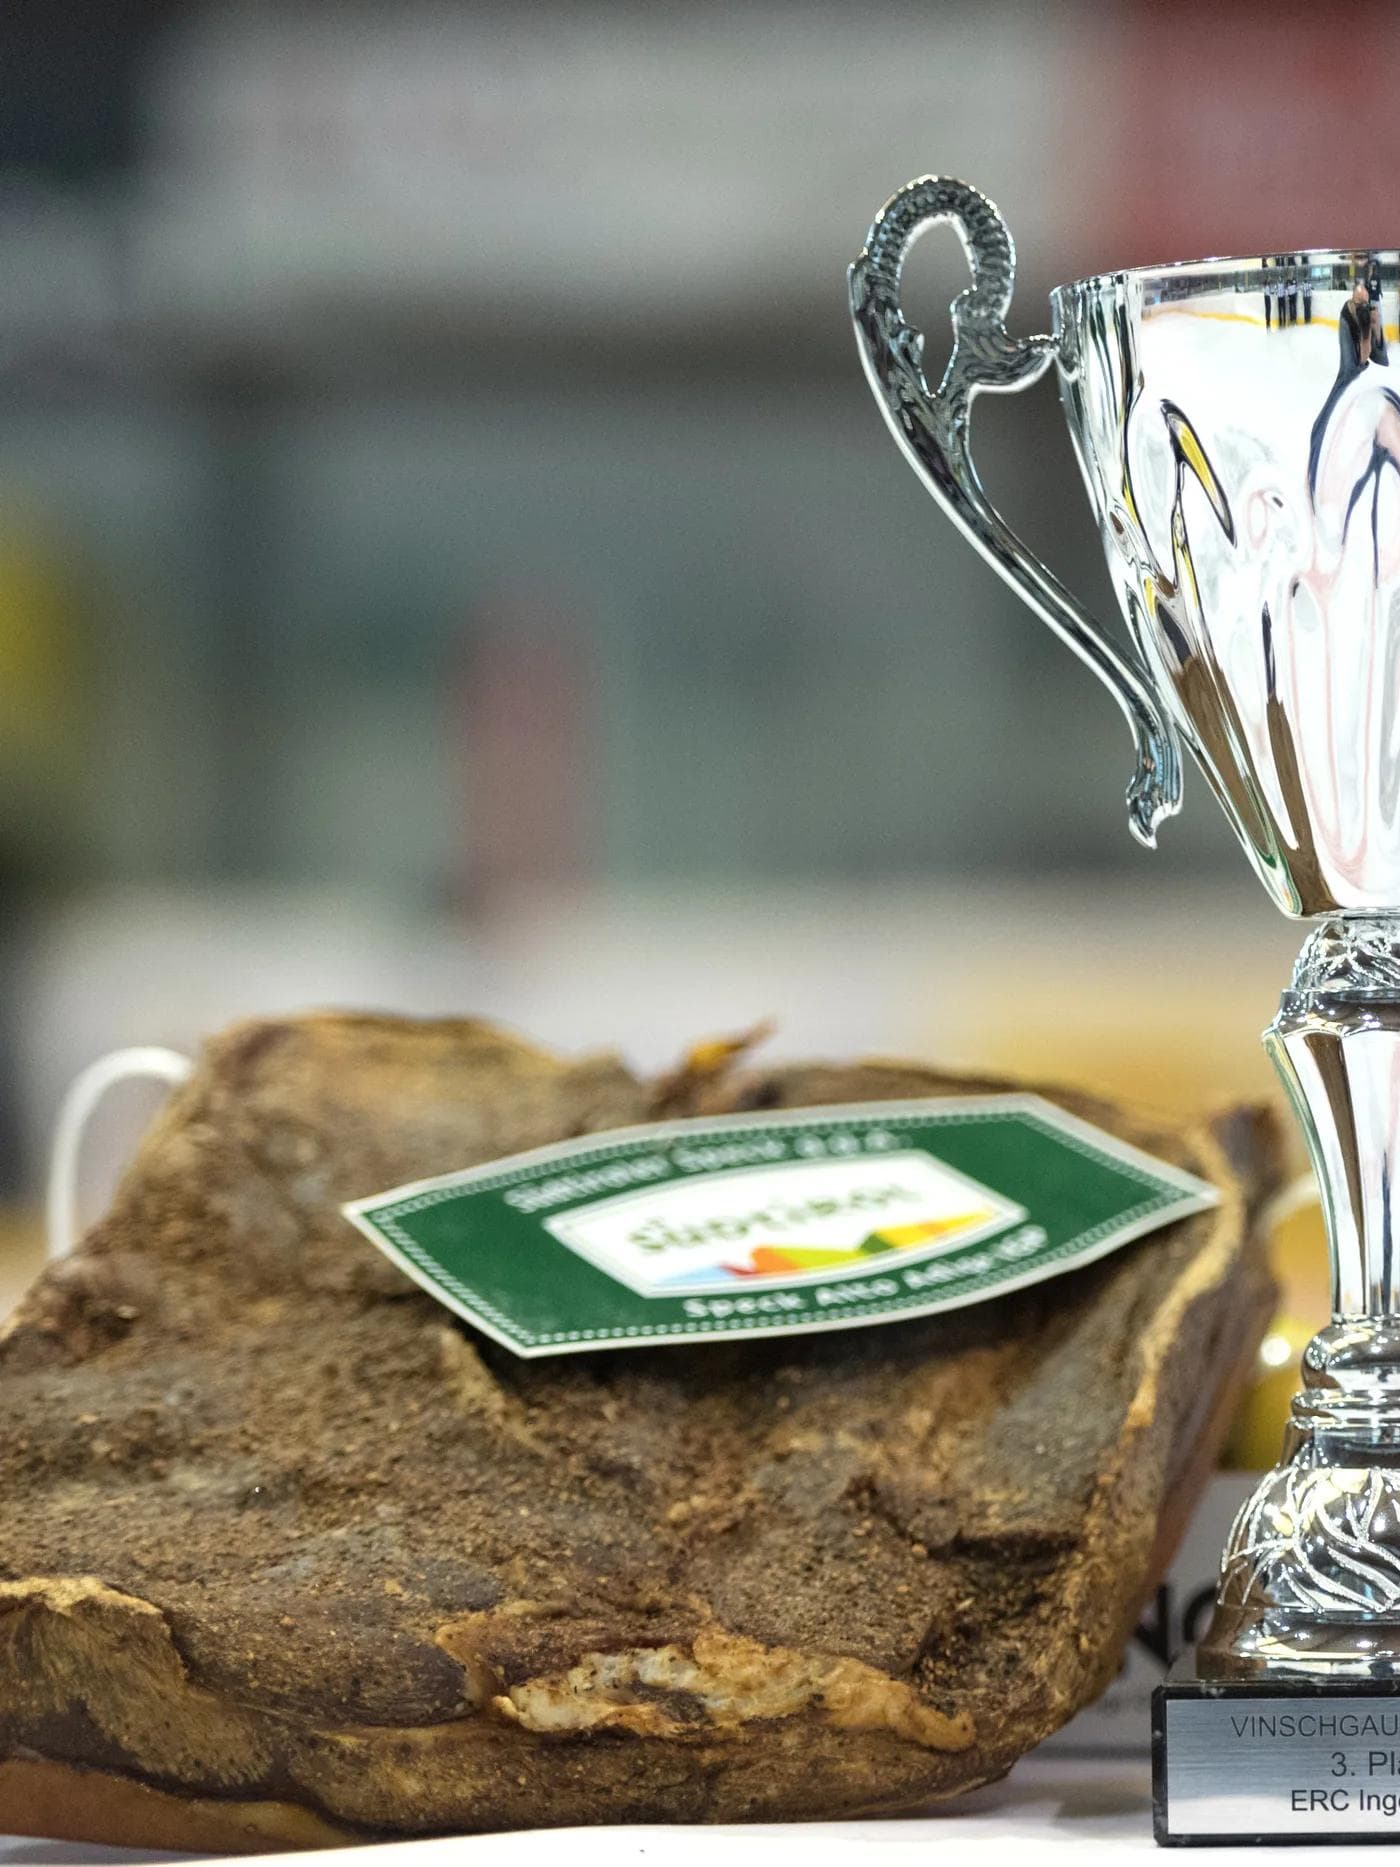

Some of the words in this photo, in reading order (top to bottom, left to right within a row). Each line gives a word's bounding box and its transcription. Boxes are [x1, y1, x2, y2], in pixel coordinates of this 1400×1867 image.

[682, 1292, 806, 1319] Speck
[1230, 1714, 1399, 1738] VINSCHGAU
[1331, 1751, 1357, 1777] 3.
[1290, 1789, 1350, 1813] ERC
